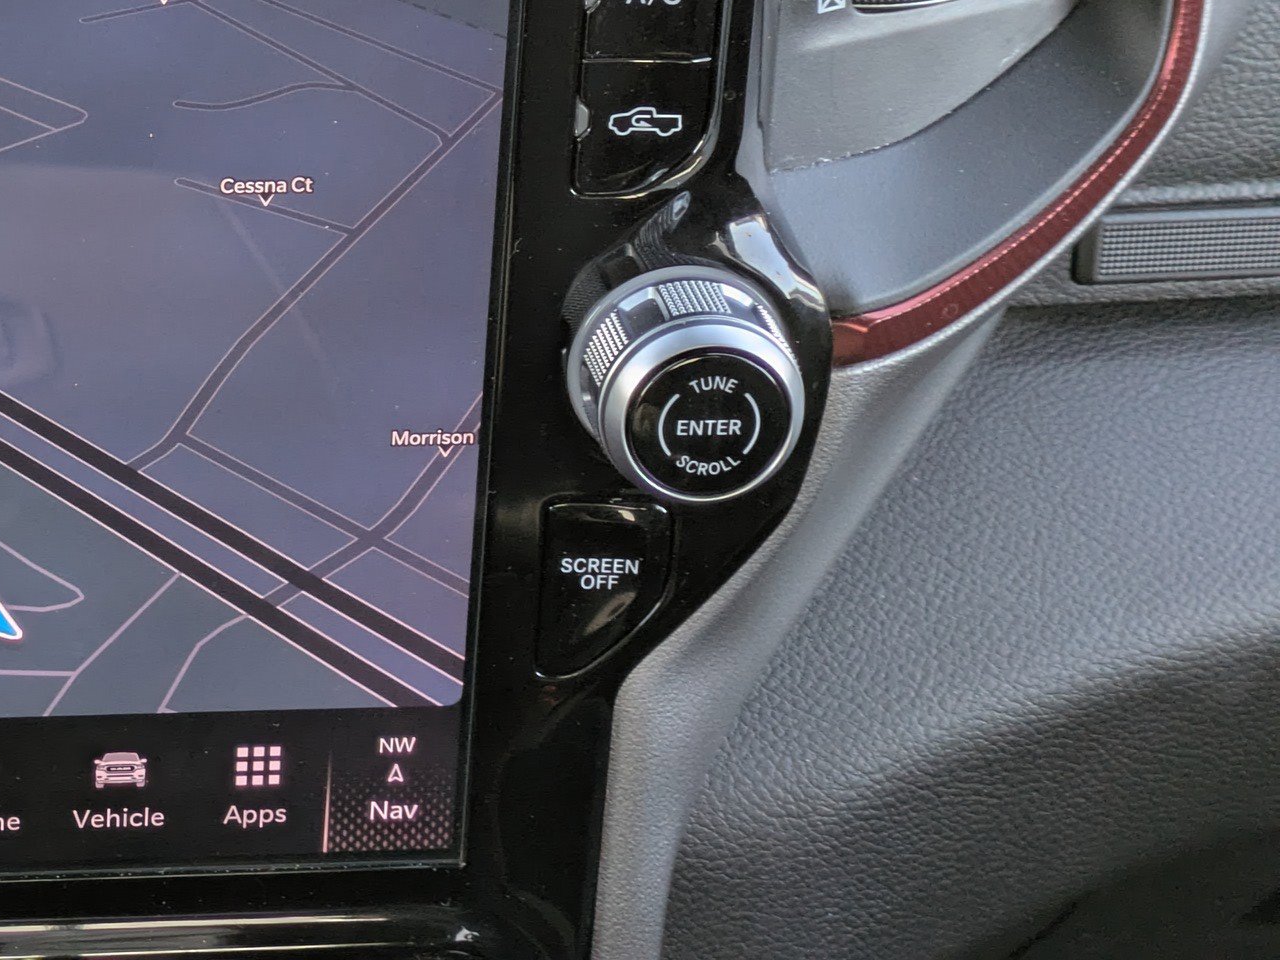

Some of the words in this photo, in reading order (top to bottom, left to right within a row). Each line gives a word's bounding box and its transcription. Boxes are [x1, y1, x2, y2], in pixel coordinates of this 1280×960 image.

[220, 178, 287, 194] Cessna
[291, 176, 313, 193] Ct
[688, 375, 739, 394] TUNE
[676, 419, 742, 436] ENTER
[391, 430, 474, 445] Morrison
[675, 455, 741, 476] SCROLL
[560, 557, 639, 574] SCREEN
[580, 574, 619, 590] OFF
[379, 736, 417, 754] NW
[72, 806, 165, 829] Vehicle
[223, 805, 287, 829] Apps
[369, 800, 419, 821] Nav
